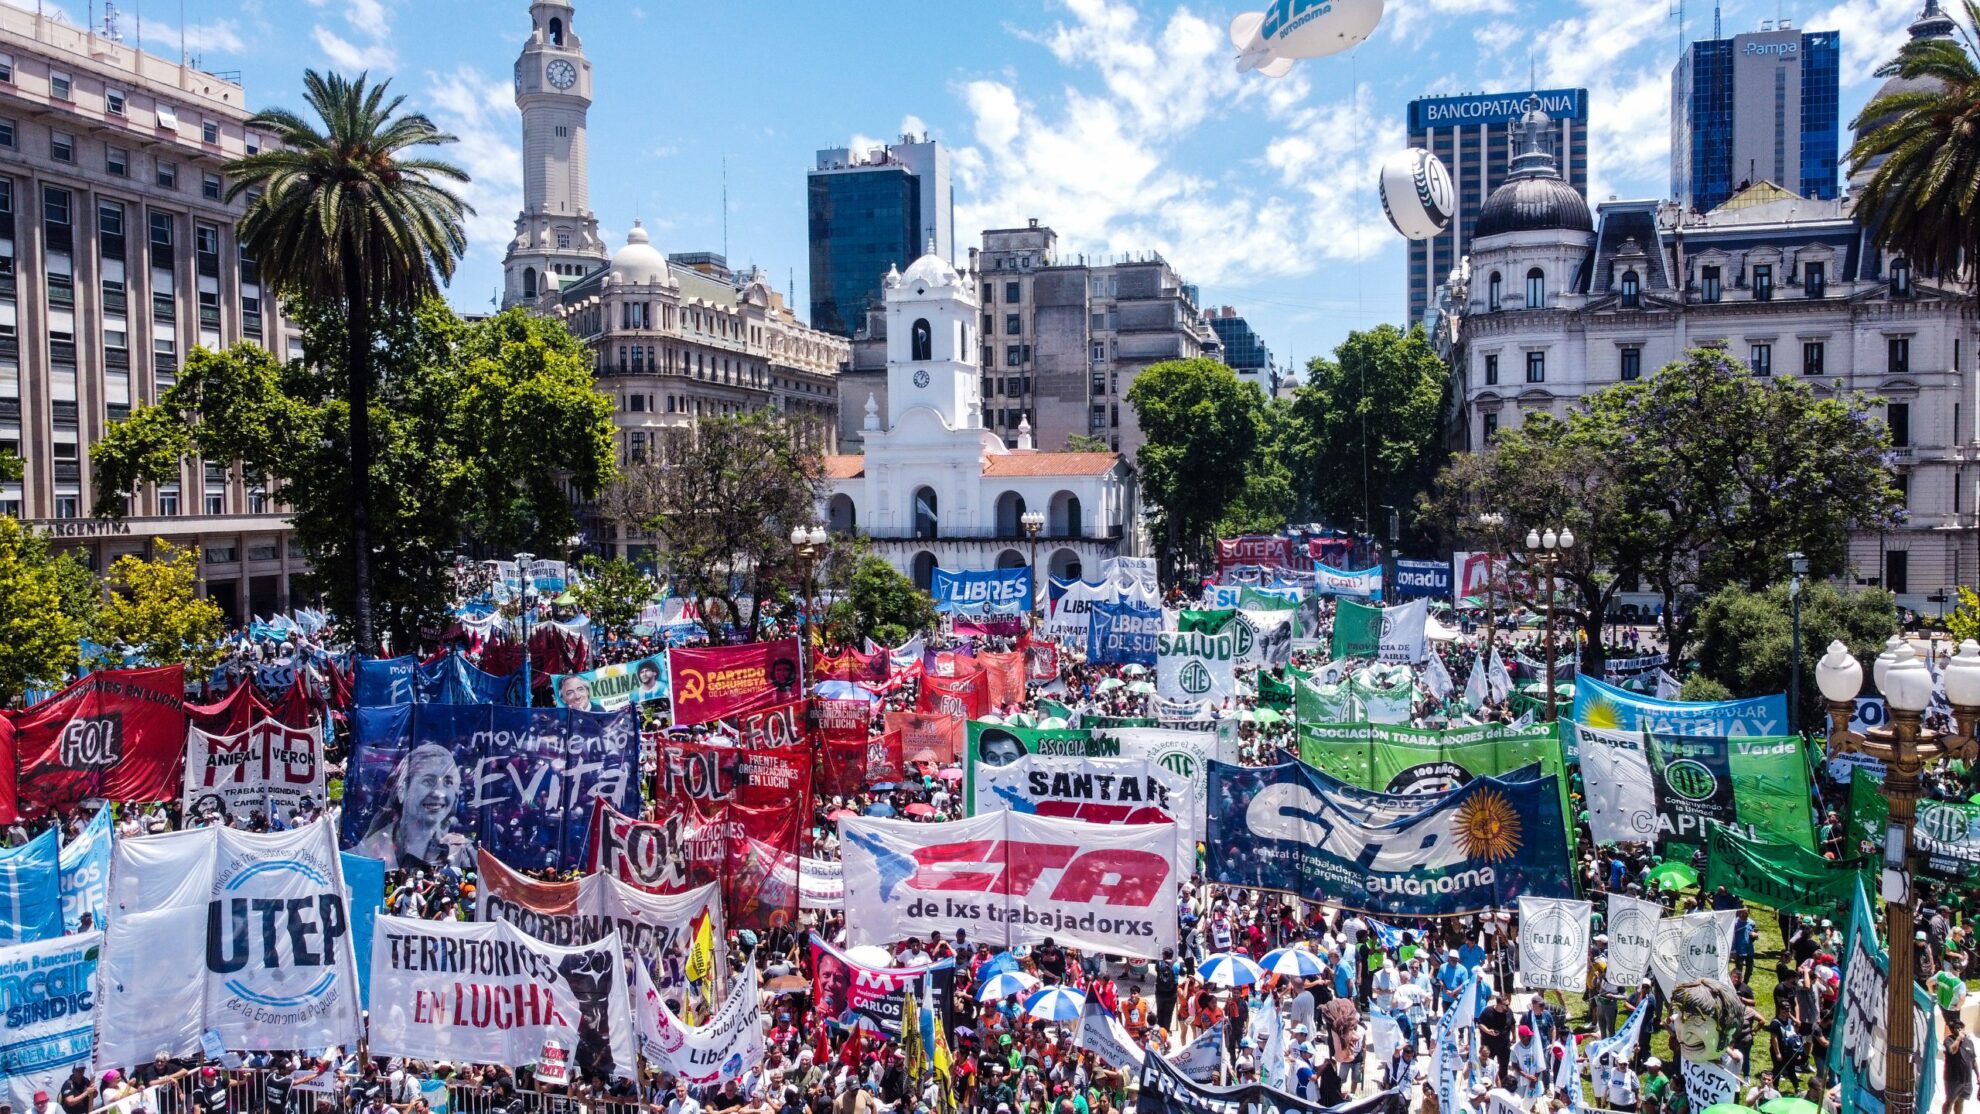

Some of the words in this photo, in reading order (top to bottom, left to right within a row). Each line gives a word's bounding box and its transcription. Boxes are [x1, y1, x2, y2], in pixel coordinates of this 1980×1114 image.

[1747, 42, 1797, 56] Pampa
[1427, 95, 1572, 121] BANCOPATAGONIA
[47, 522, 131, 537] ARGENTINA
[1222, 541, 1286, 558] SUTEPA
[951, 577, 1027, 601] LIBRES
[1158, 633, 1235, 661] SALUD
[591, 674, 640, 698] KOLINA
[707, 667, 766, 683] PARTIDO
[707, 677, 768, 692] COMUNISTA
[1181, 663, 1210, 691] ATE
[819, 701, 848, 710] FRENTE
[941, 695, 962, 715] FOL
[745, 704, 804, 750] FOL
[819, 719, 830, 729] EN
[832, 718, 857, 730] LUCHA
[1311, 726, 1389, 741] ASOCIACIÓN
[60, 719, 117, 767] FOL
[471, 726, 628, 756] movimiento
[1037, 732, 1121, 757] ASOCIACIÓN
[1580, 729, 1639, 750] Blanca
[1737, 742, 1796, 755] Verde
[204, 722, 315, 787] MTD
[206, 749, 261, 767] ANIBAL
[749, 754, 778, 765] FRENTE
[466, 754, 630, 809] Evita
[664, 747, 737, 800] FOL
[738, 763, 799, 780] ORGANIZACIONES
[749, 775, 765, 788] EN
[767, 776, 789, 789] LUCHA
[1413, 766, 1434, 777] 100
[1437, 765, 1461, 777] AÑOS
[224, 786, 265, 796] TRABAJO
[268, 786, 301, 796] DIGNIDAD
[1028, 771, 1142, 802] SANTA
[1631, 810, 1757, 839] CAPIAL
[1252, 846, 1290, 860] central
[211, 869, 232, 896] Unión
[231, 857, 243, 871] de
[901, 839, 1170, 907] CTA
[1313, 867, 1363, 889] argentina
[1366, 866, 1495, 896] autónoma
[907, 899, 939, 918] de
[946, 897, 981, 920] lxs
[986, 903, 1154, 937] trabajadorxs
[206, 893, 347, 974] UTEP
[31, 948, 83, 969] Bancaria
[387, 933, 558, 984] TERRITORIOS
[1523, 970, 1581, 989] AGRARIOS
[226, 997, 242, 1009] de
[242, 1004, 252, 1017] la
[254, 1007, 307, 1025] Economía
[308, 986, 339, 1017] Popular
[414, 989, 447, 1025] EN
[452, 981, 568, 1031] LUCHA
[853, 997, 900, 1016] CARLOS
[1084, 1023, 1115, 1049] Queremos
[1087, 1037, 1099, 1048] del
[1143, 1066, 1240, 1114] FRENTE
